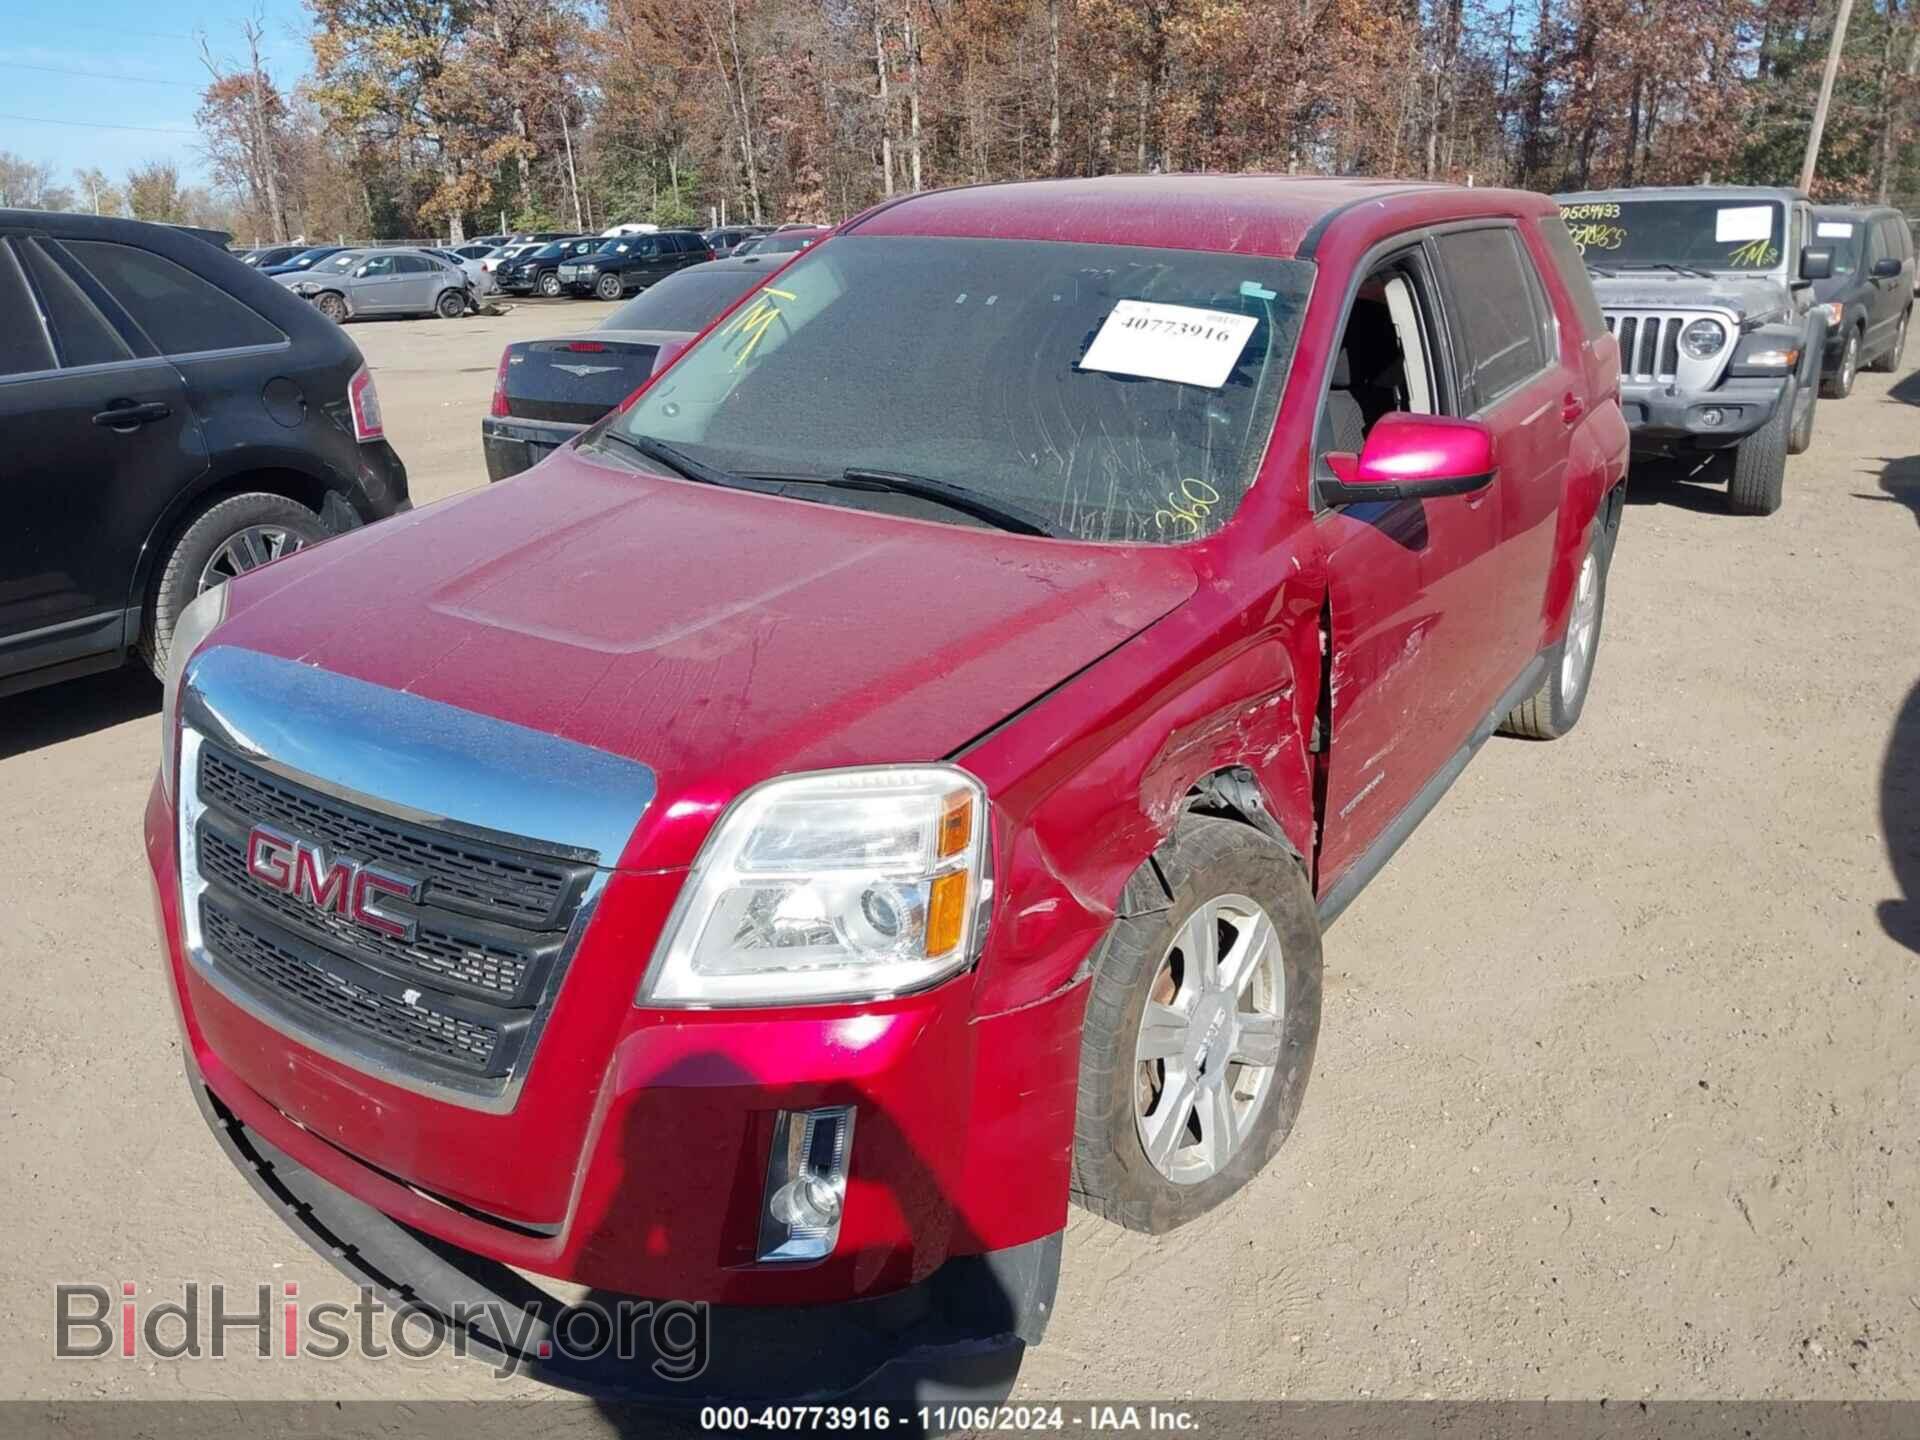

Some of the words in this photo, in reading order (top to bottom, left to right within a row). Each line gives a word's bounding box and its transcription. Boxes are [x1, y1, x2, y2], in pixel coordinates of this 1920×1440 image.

[1121, 317, 1230, 342] 40773916
[1155, 478, 1220, 534] 360
[246, 823, 424, 943] GMC
